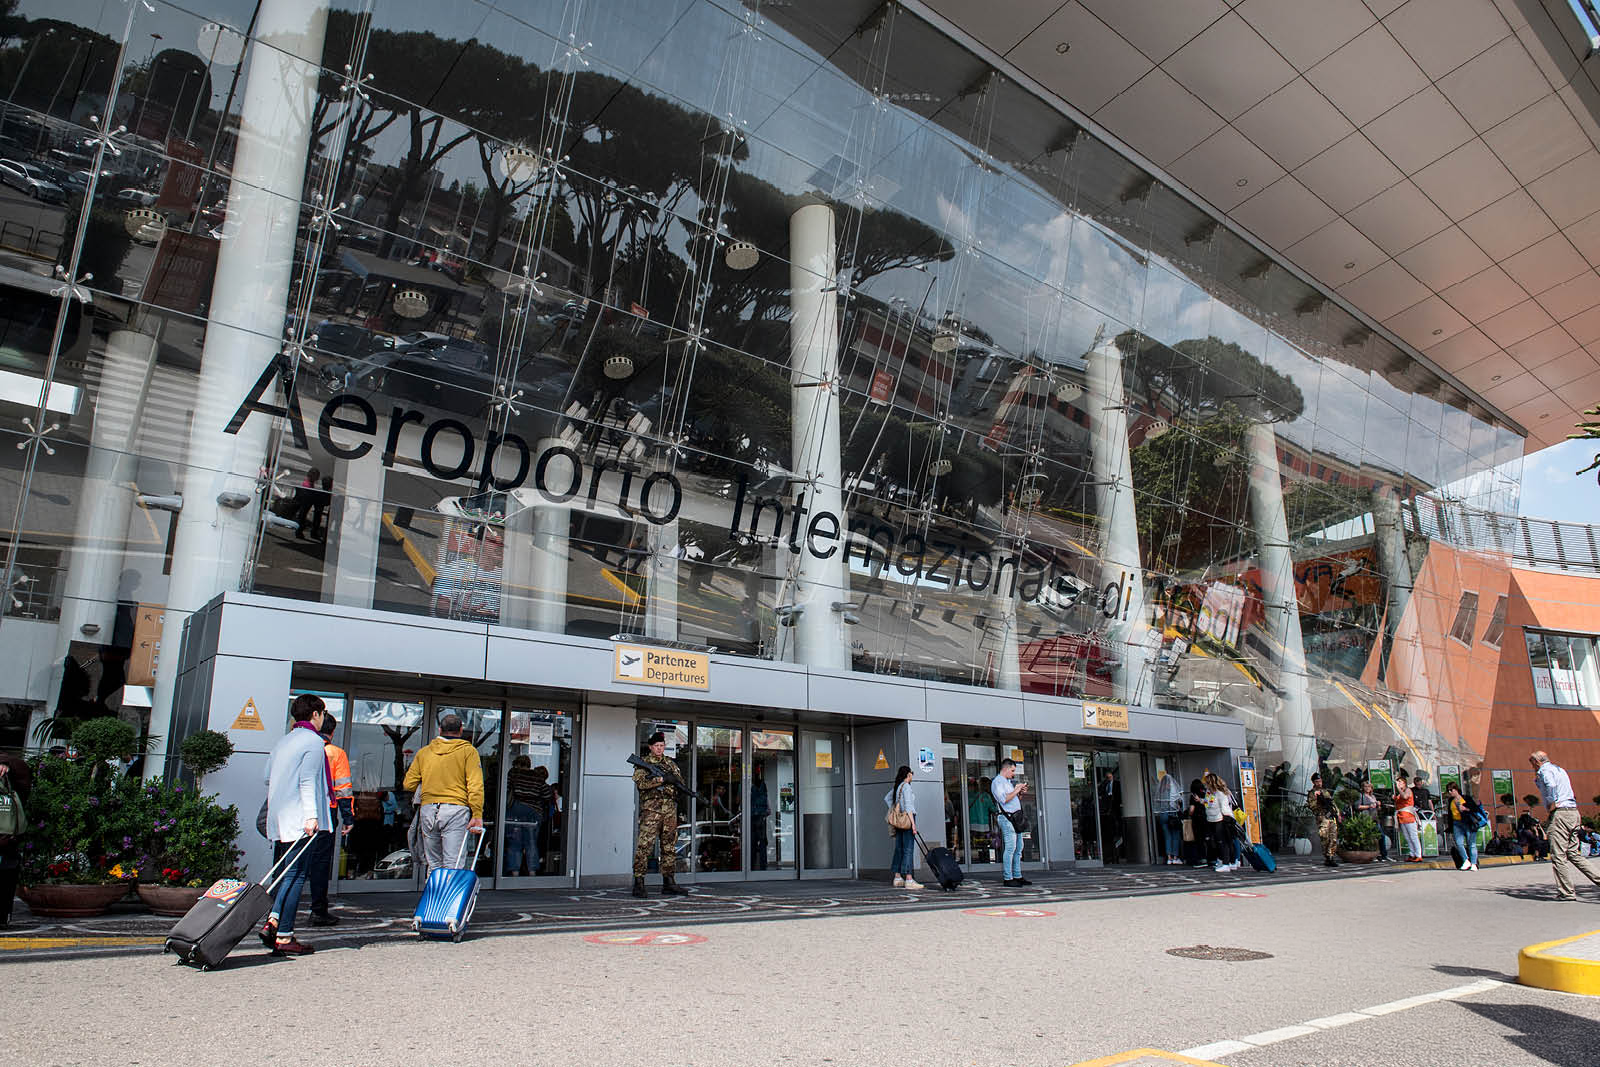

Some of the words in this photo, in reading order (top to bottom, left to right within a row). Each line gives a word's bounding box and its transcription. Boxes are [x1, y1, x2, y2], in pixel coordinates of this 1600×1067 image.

[223, 353, 683, 526] Aeroporto
[729, 473, 1077, 610] Internazionale
[1102, 570, 1135, 622] di
[647, 652, 697, 669] Partenze
[647, 667, 705, 685] Departures
[1097, 706, 1123, 718] Partenze
[1097, 717, 1128, 729] Departures
